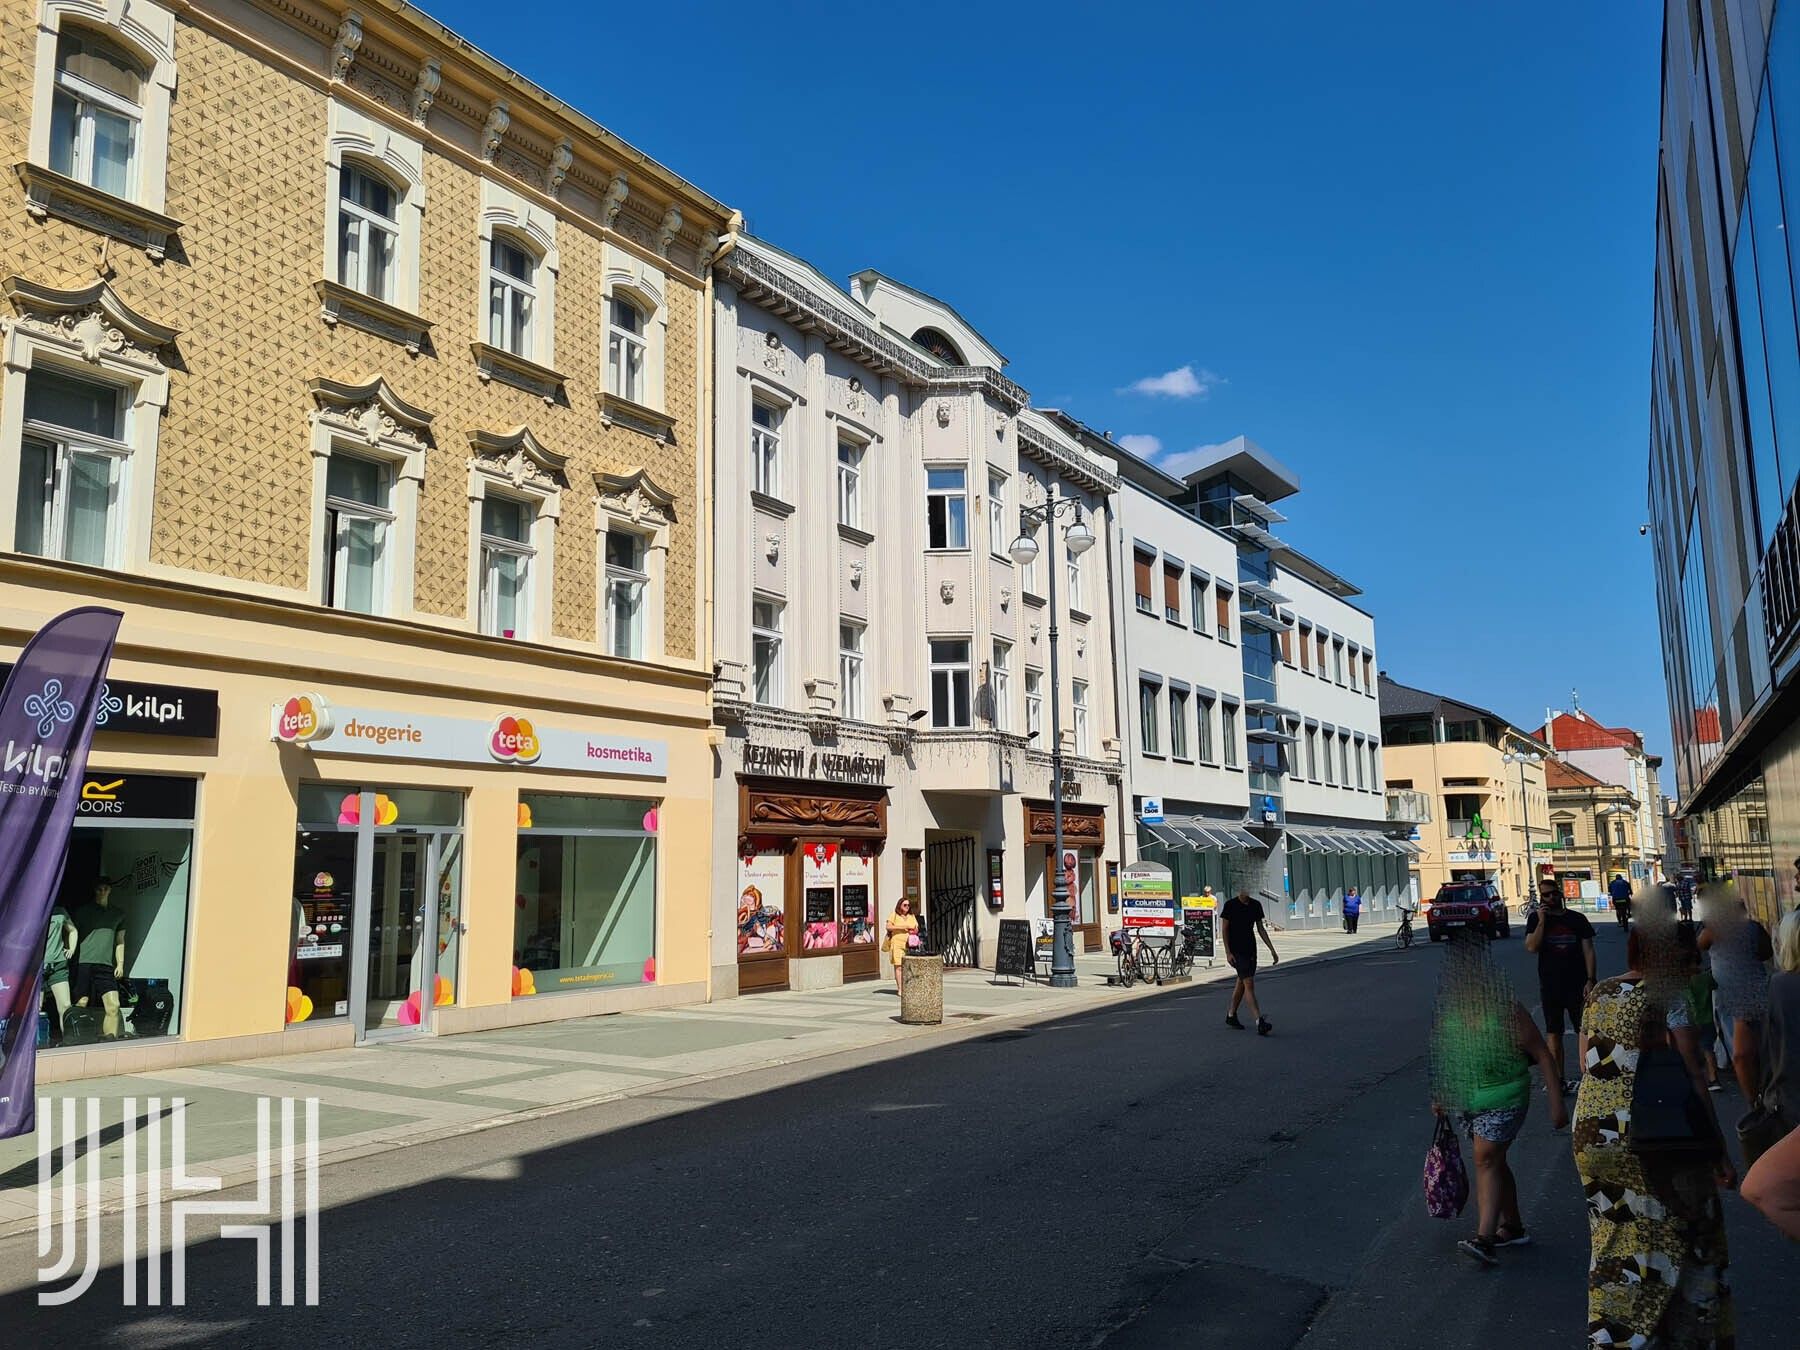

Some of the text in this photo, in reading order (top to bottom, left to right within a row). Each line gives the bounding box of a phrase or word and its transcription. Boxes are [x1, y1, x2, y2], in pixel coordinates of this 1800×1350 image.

[127, 694, 183, 722] kilpi
[283, 712, 312, 730] teta
[344, 718, 422, 744] drogerie
[498, 731, 534, 750] teta
[4, 740, 67, 782] kilpi
[587, 742, 652, 763] kosmetika
